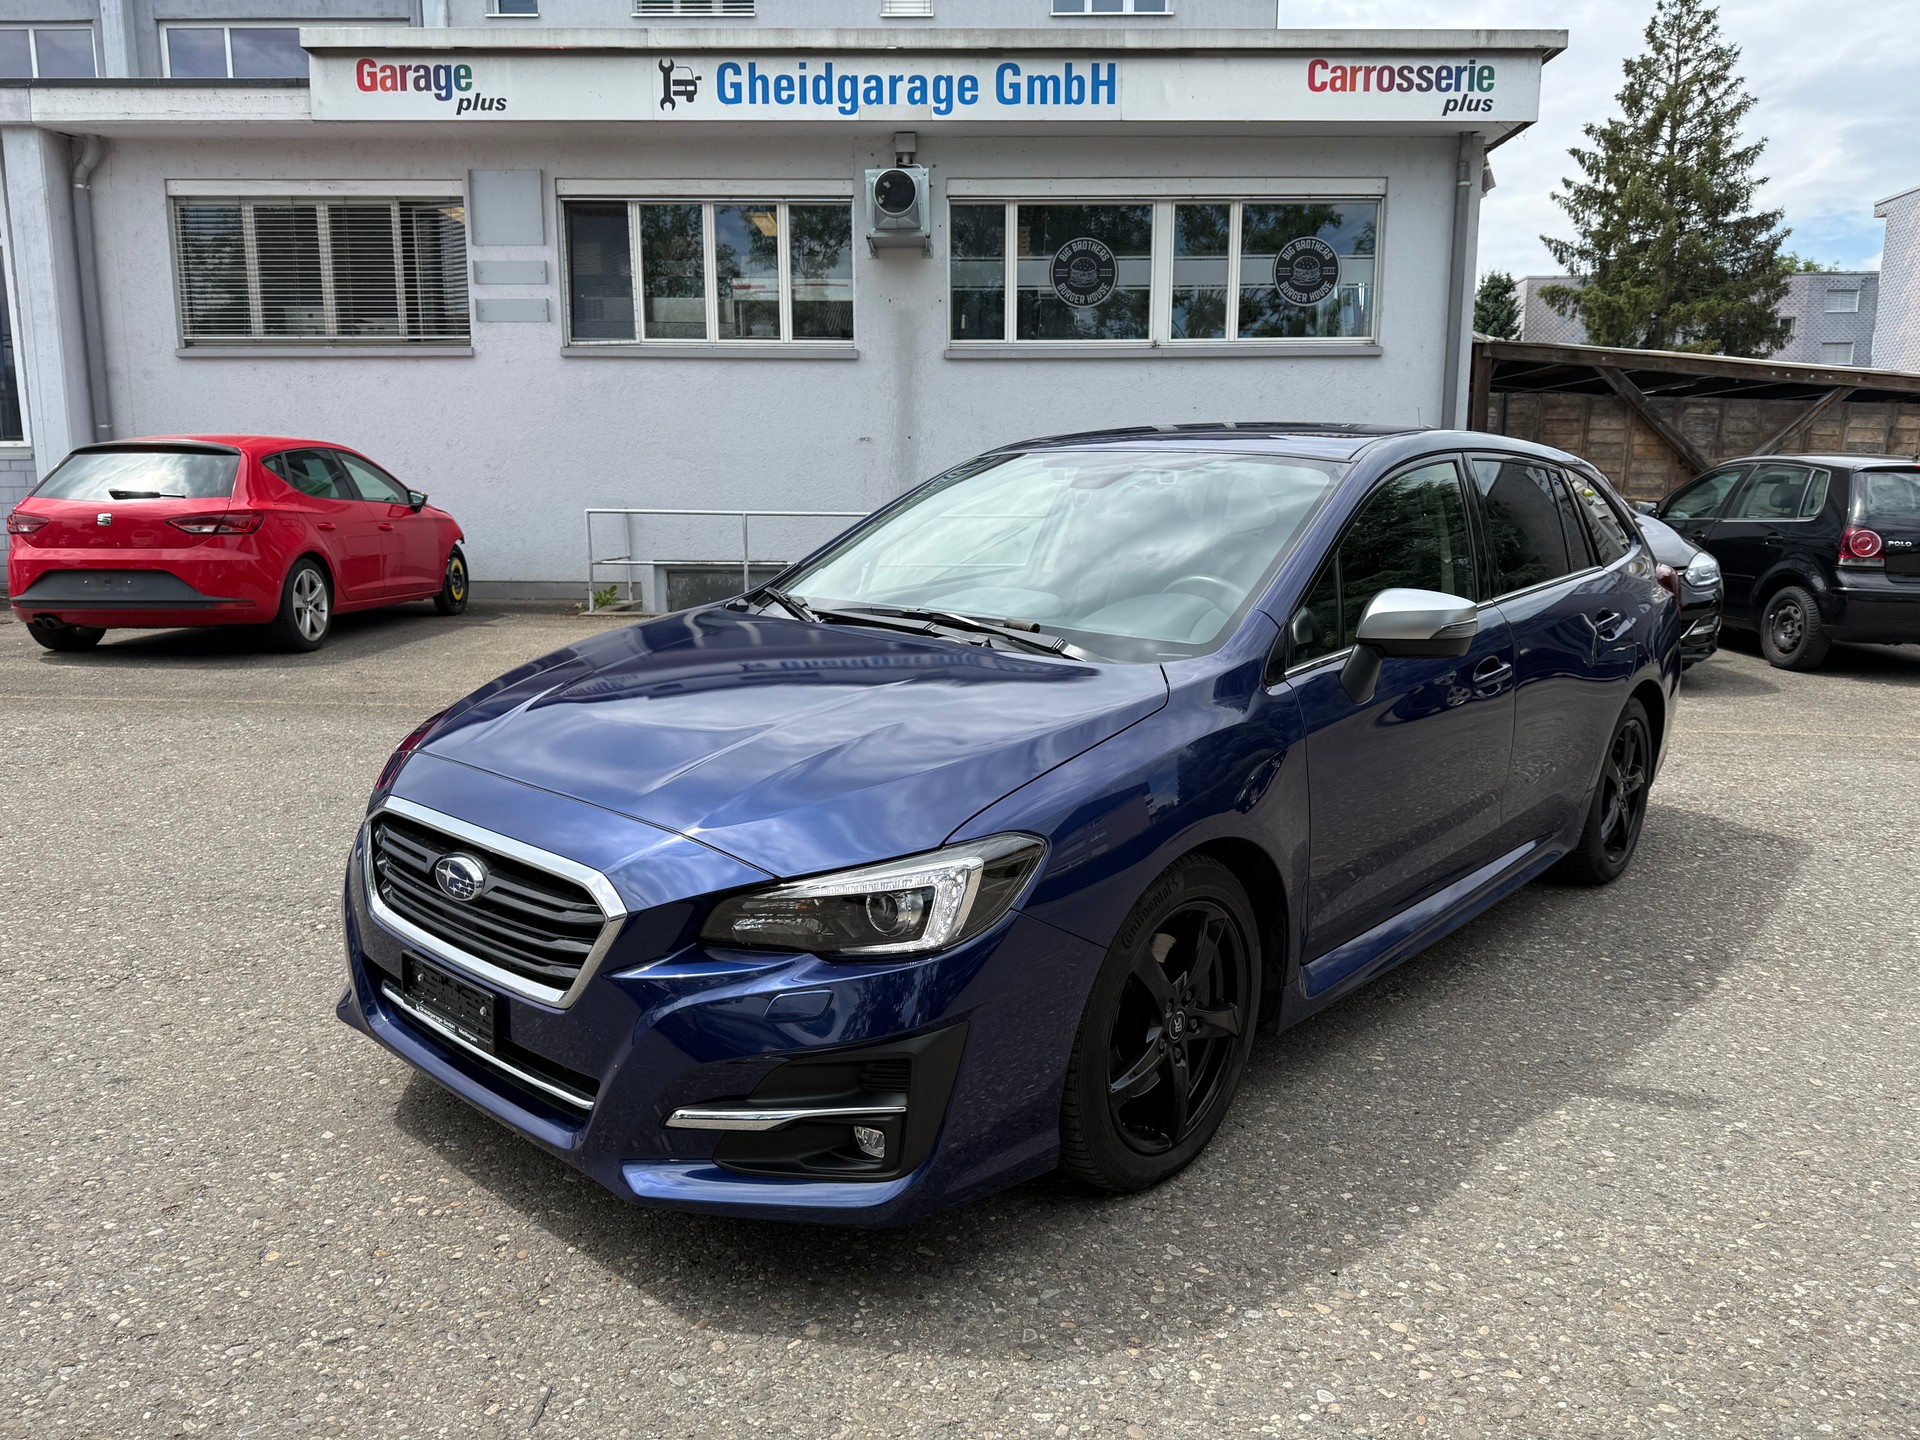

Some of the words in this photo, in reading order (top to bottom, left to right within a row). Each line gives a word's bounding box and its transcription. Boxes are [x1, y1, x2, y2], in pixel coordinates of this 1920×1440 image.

[356, 58, 473, 100] Garage
[1307, 59, 1496, 92] Carrosserie
[717, 61, 980, 115] Gheidgarage
[996, 62, 1116, 105] GmbH
[456, 93, 507, 115] plus
[1442, 93, 1494, 116] plus
[1058, 247, 1072, 262] BIG
[1071, 240, 1110, 262] BROTHERS
[1281, 246, 1296, 261] BIG
[1294, 239, 1334, 260] BROTHERS
[1057, 282, 1085, 304] BURGER
[1086, 282, 1110, 304] HOUSE
[1279, 281, 1308, 303] BURGER
[1309, 280, 1333, 302] HOUSE
[1121, 881, 1172, 950] Continental
